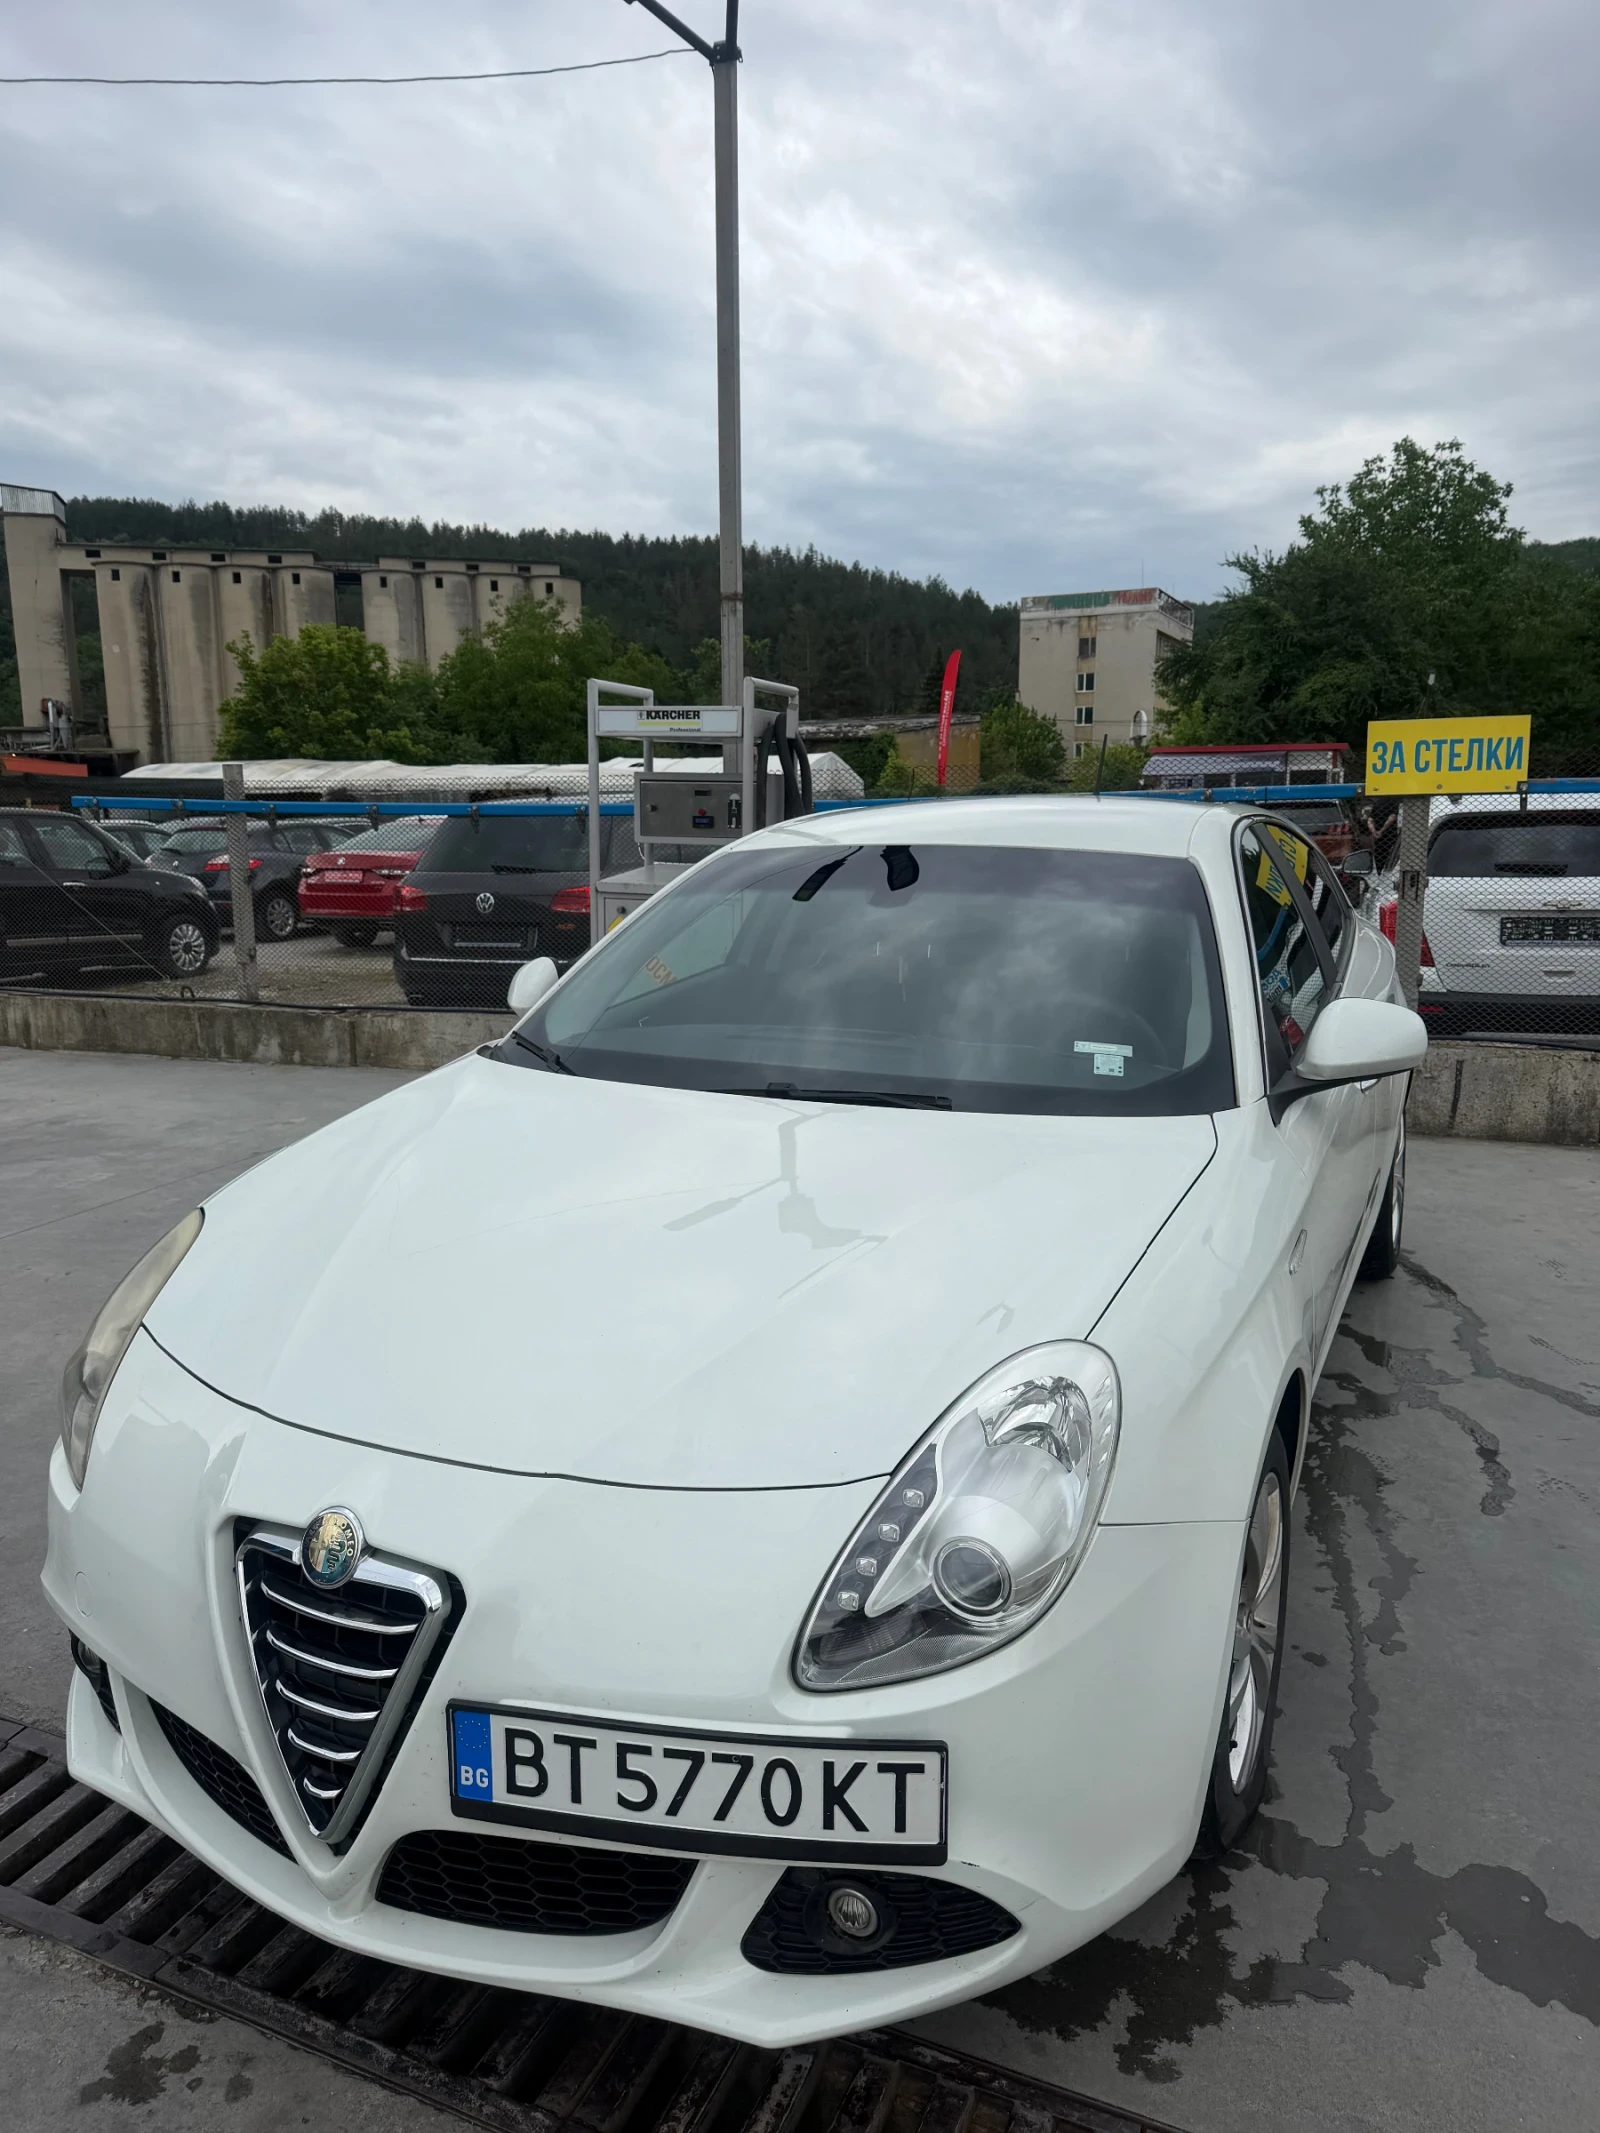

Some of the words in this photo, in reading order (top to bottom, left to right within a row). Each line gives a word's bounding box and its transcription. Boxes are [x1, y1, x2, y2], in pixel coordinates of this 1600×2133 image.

[1372, 741, 1406, 774] ЗА
[1414, 736, 1524, 773] СТЕЛКИ
[460, 1765, 489, 1788] BG
[505, 1727, 597, 1804] BT
[615, 1741, 803, 1827] 5770
[822, 1760, 926, 1833] KT
